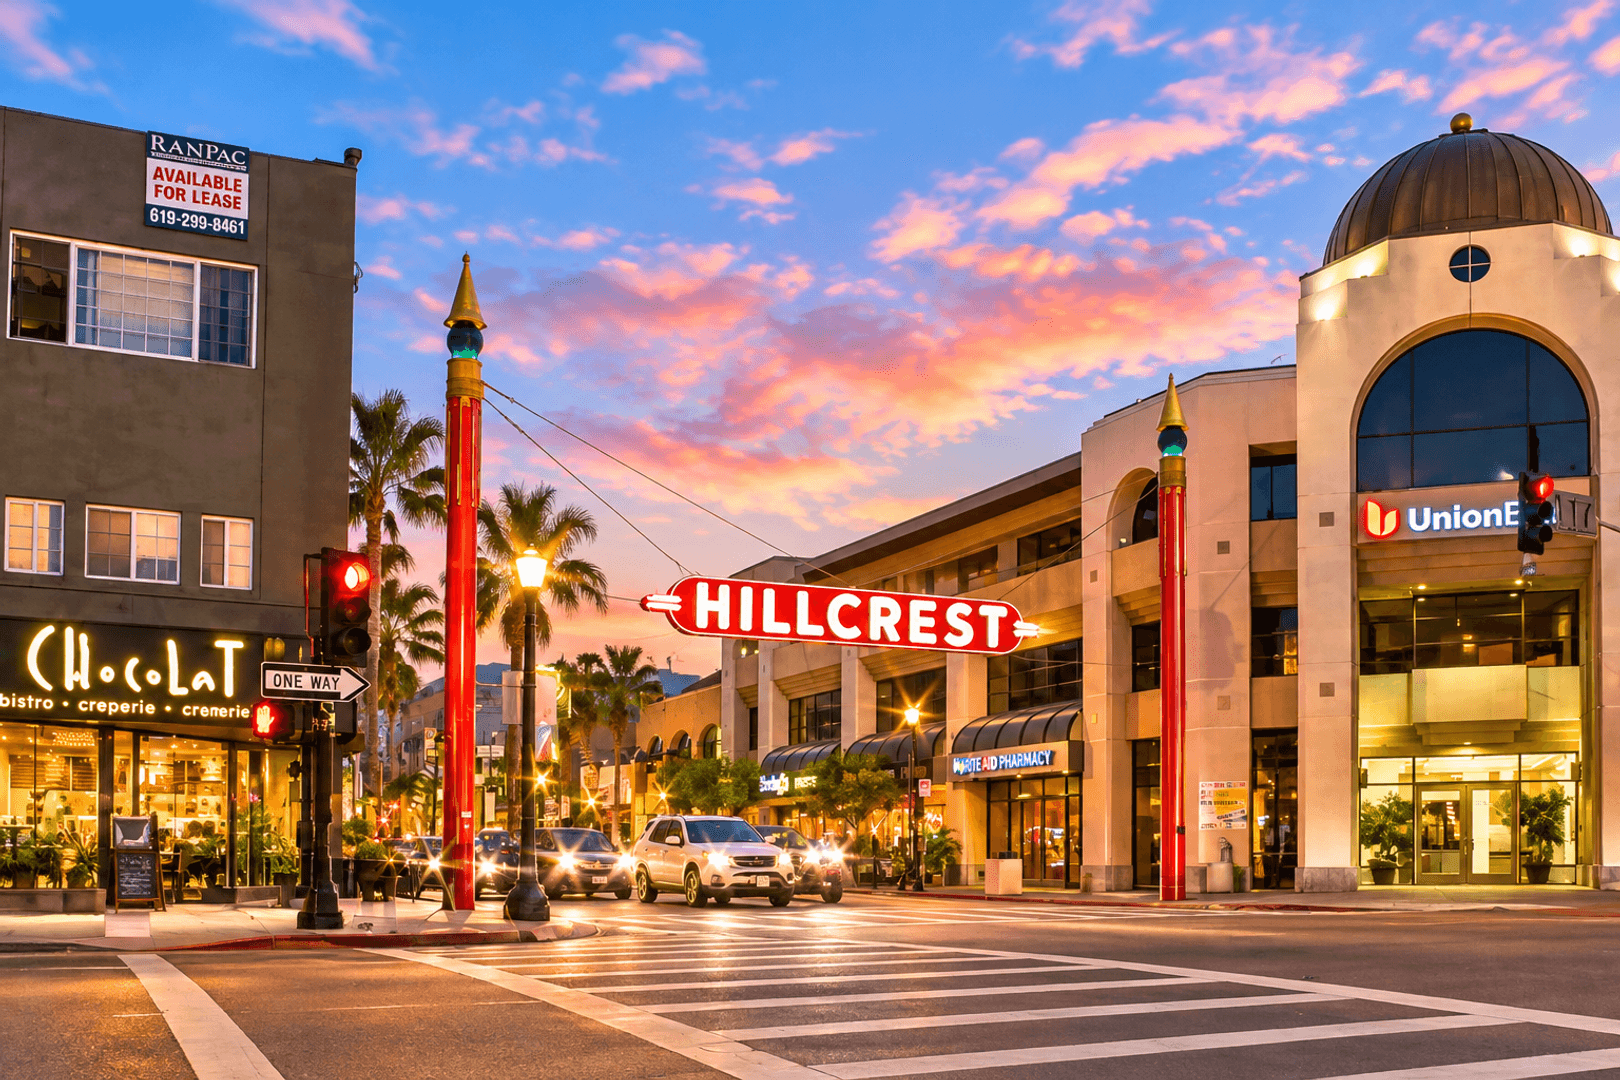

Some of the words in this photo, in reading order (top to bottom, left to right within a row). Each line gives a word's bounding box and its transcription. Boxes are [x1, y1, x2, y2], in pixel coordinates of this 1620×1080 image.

[153, 166, 242, 193] AVAILABLE
[154, 184, 186, 202] FOR
[192, 190, 242, 210] LEASE
[150, 207, 244, 235] 619-299-8461
[695, 581, 1008, 649] HILLCREST
[273, 673, 303, 689] ONE
[310, 675, 340, 691] WAY
[0, 693, 54, 710] bistro
[78, 700, 156, 716] creperie
[182, 704, 250, 719] cremerie
[999, 750, 1052, 769] PHARMACY
